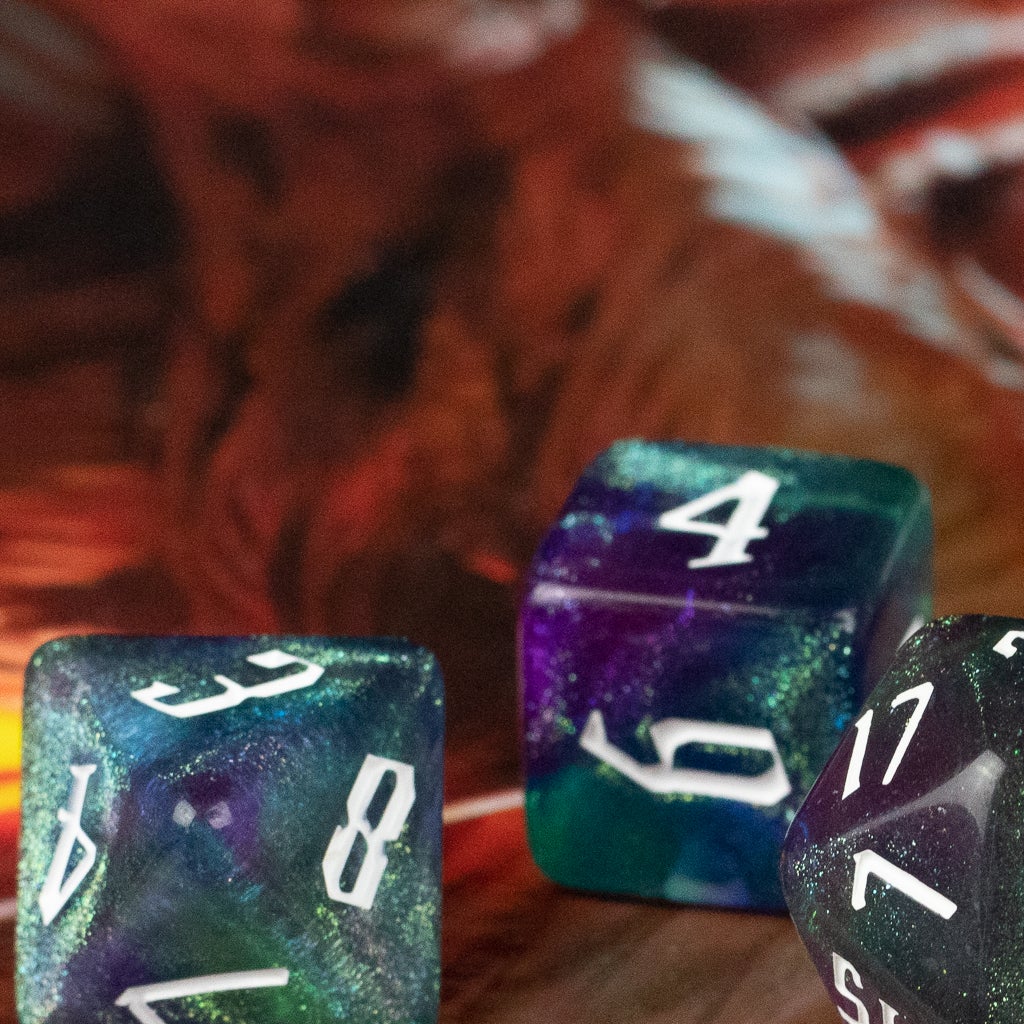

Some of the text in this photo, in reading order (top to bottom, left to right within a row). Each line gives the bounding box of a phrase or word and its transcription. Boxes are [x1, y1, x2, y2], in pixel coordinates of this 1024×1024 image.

[657, 470, 781, 569] 4
[130, 649, 326, 719] 3
[579, 708, 792, 807] 6
[841, 681, 934, 800] 17
[38, 763, 98, 926] 4
[321, 753, 417, 911] 8
[850, 848, 958, 920] 7
